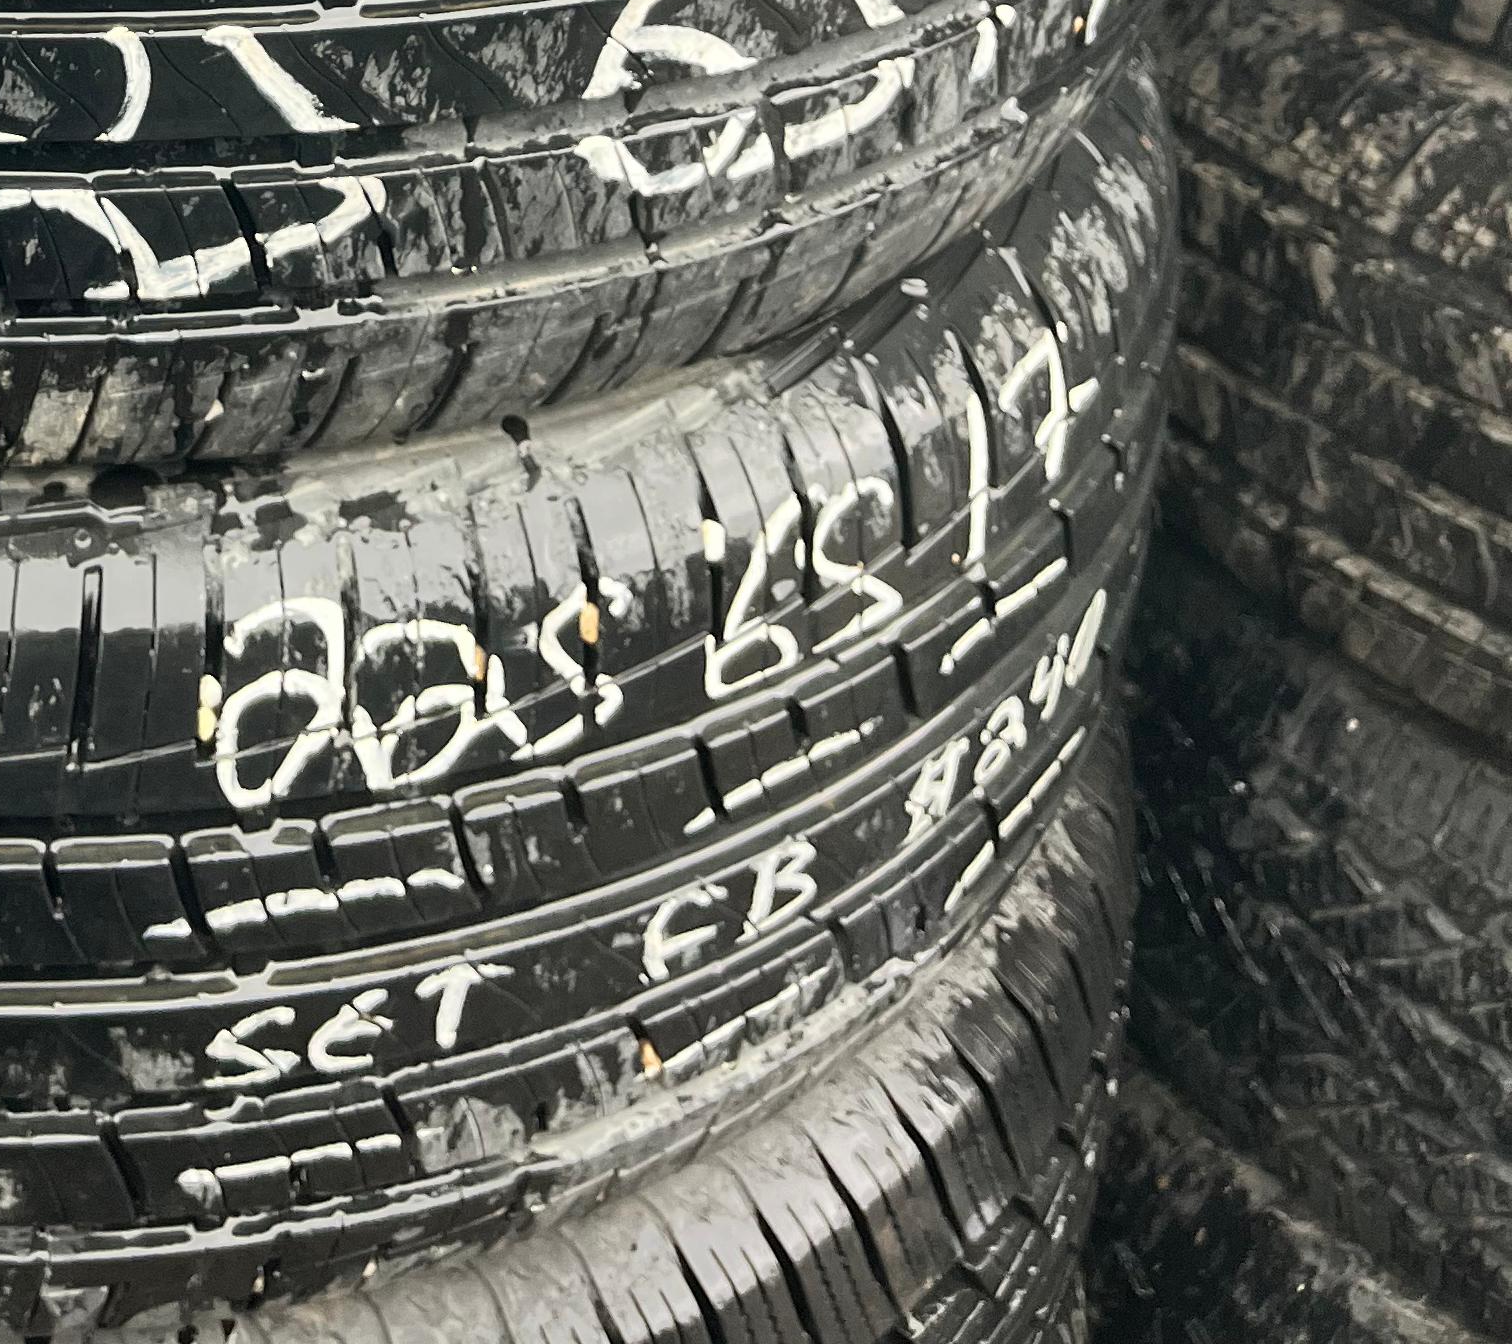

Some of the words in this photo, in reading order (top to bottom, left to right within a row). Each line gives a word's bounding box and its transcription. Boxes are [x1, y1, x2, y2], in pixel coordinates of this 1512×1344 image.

[214, 576, 633, 810] 225
[704, 475, 904, 700] 65
[965, 320, 1100, 583] 17
